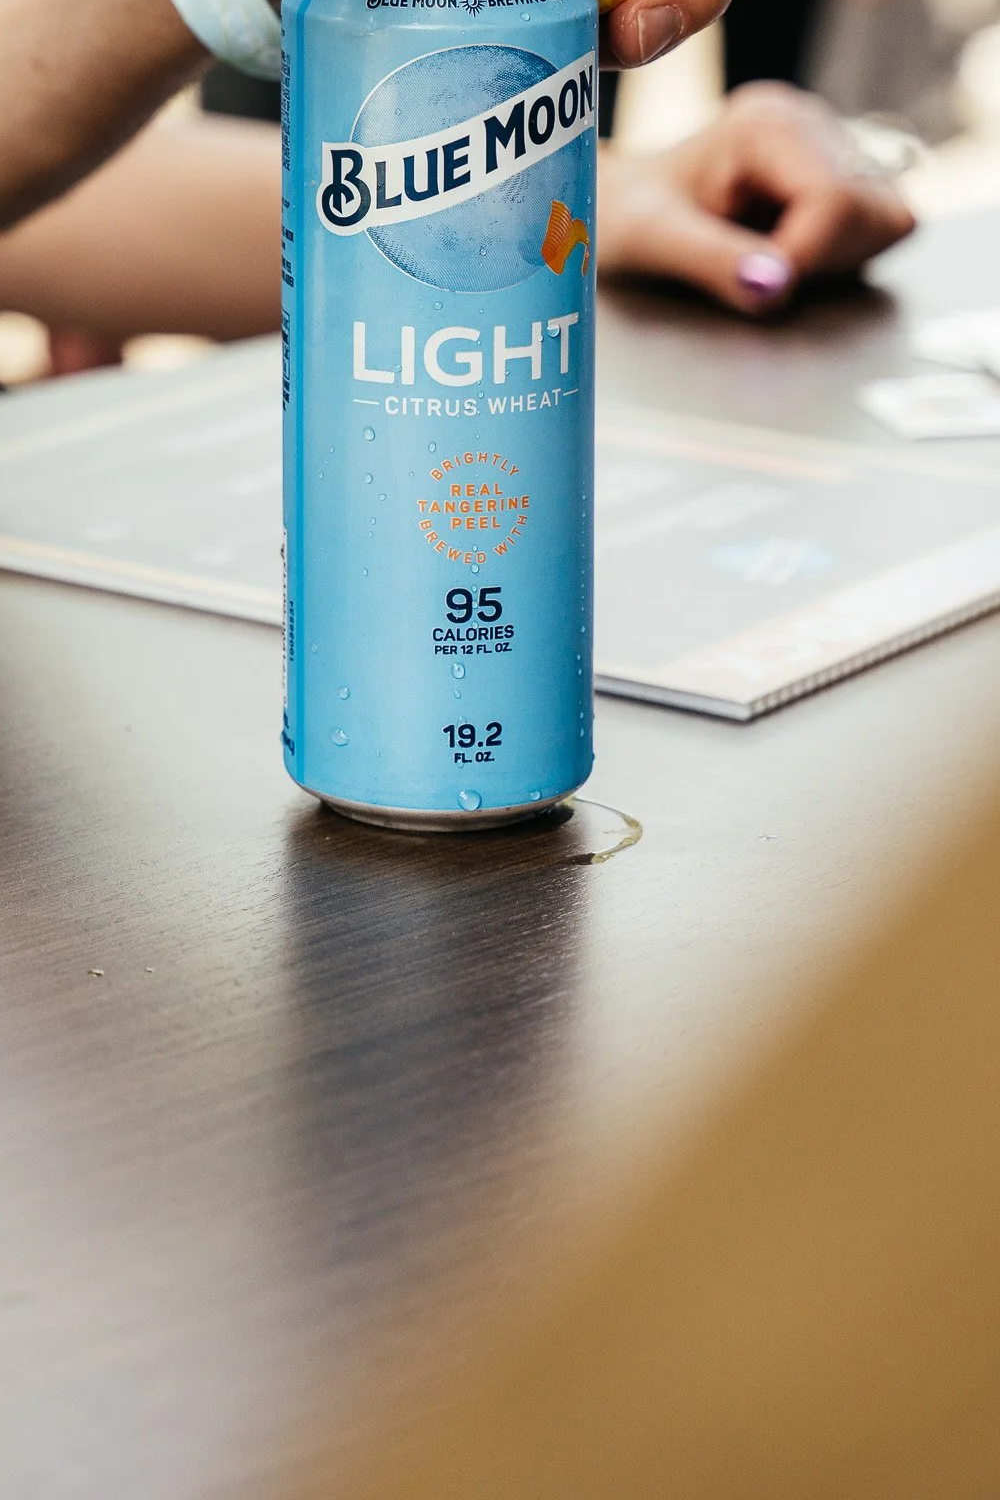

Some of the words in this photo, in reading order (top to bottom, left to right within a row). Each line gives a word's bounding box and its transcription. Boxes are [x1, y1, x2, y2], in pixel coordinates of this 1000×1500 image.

[321, 135, 471, 227] BLUE
[484, 64, 595, 175] MOON
[353, 312, 579, 387] LIGHT
[384, 396, 477, 416] CITRUS
[488, 388, 562, 414] WHEAT
[430, 452, 520, 481] BRIGHTLY
[451, 482, 503, 497] REAL
[418, 496, 530, 513] TANGERINE
[451, 516, 501, 530] PEEL
[419, 519, 487, 564] BREWED
[494, 514, 528, 556] WITH
[446, 586, 503, 623] 95
[432, 624, 514, 641] CALORIES
[434, 645, 458, 655] PER
[460, 644, 473, 654] 12
[442, 721, 503, 749] 19.2
